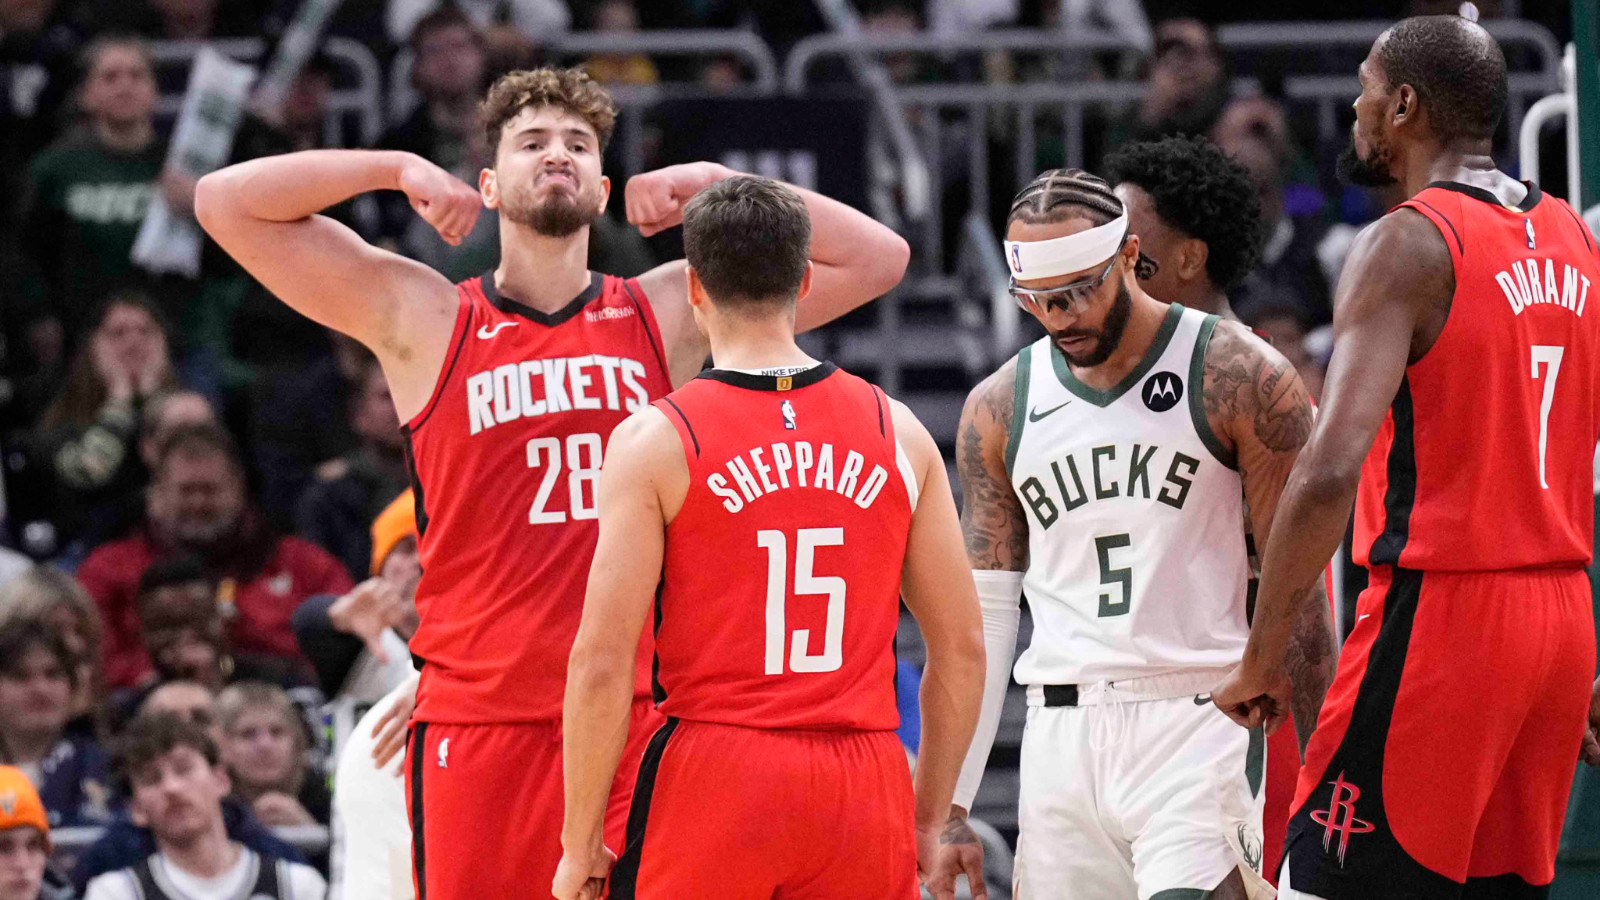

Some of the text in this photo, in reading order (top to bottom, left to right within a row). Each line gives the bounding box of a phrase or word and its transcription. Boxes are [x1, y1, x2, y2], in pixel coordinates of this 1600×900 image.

[1494, 258, 1591, 317] DURANT
[466, 353, 649, 436] ROCKETS
[761, 368, 786, 377] NIKE
[1530, 345, 1565, 489] 7
[526, 432, 603, 524] 28
[706, 441, 888, 514] SHEPPARD
[1019, 443, 1201, 530] BUCKS
[756, 527, 847, 676] 15
[1094, 532, 1133, 618] 5
